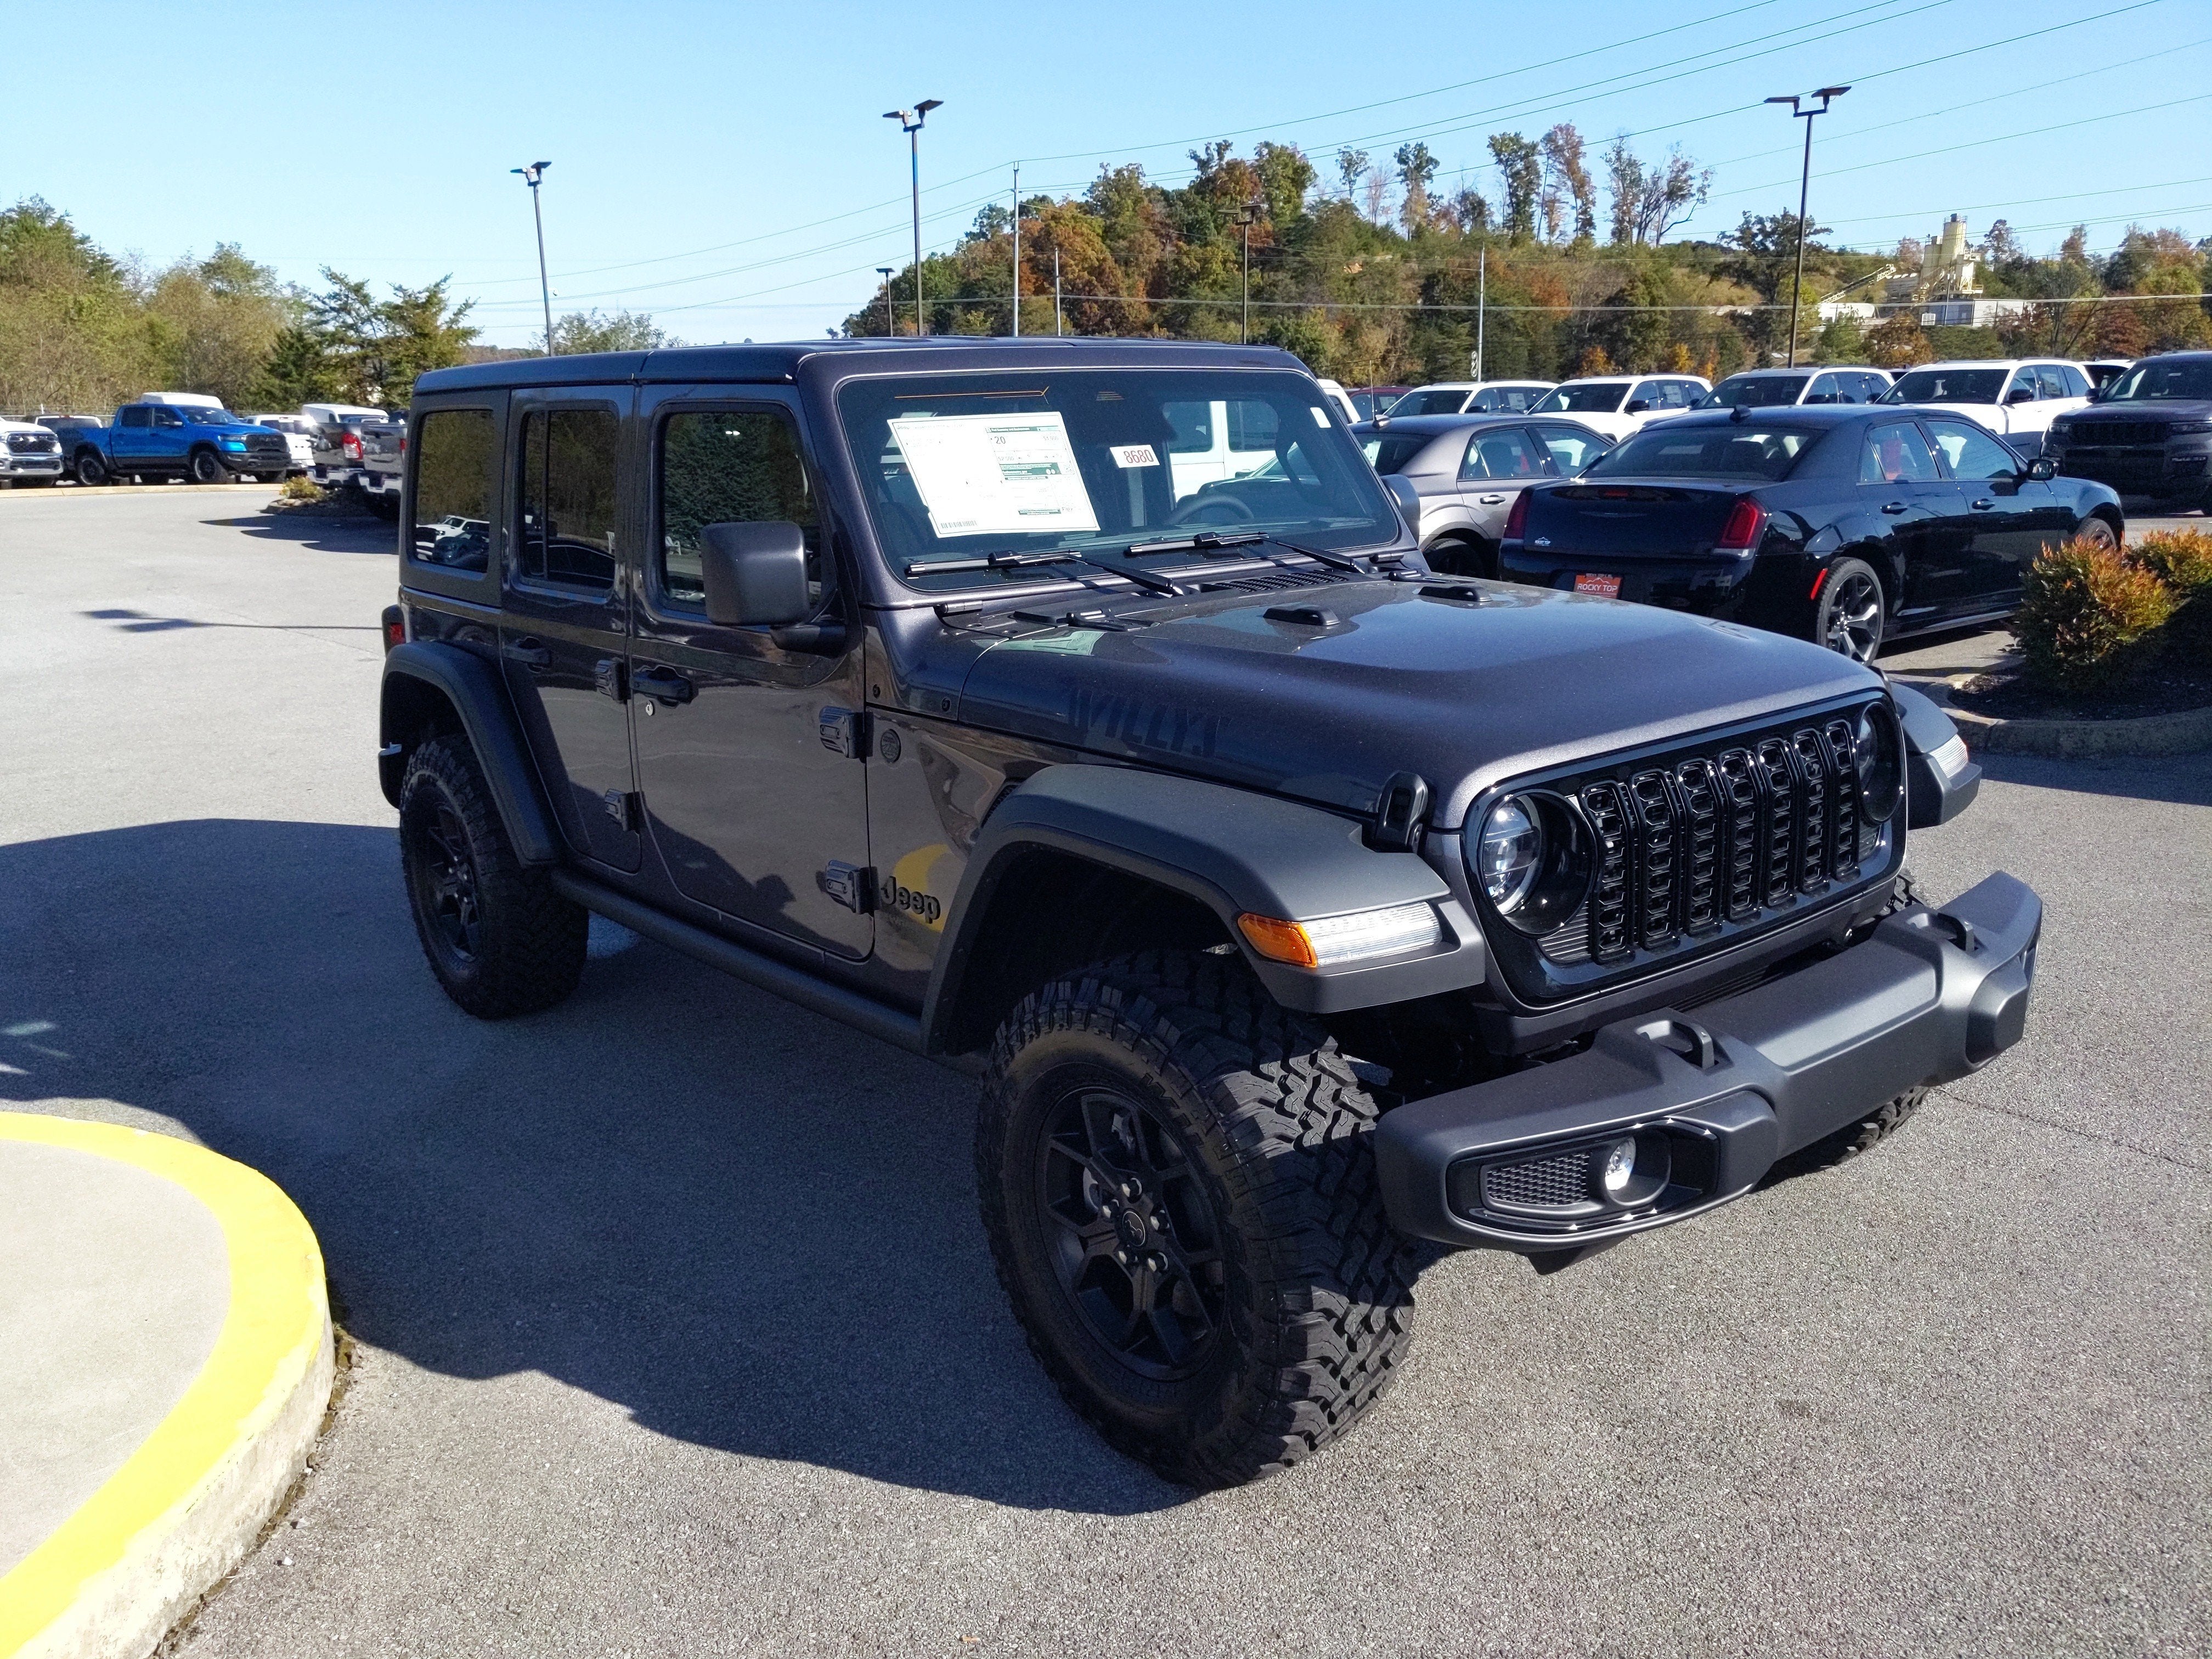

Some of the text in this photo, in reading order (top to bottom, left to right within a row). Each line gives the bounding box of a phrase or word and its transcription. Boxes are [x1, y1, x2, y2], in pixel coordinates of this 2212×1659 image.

[994, 436, 1006, 444] 20
[1123, 449, 1154, 464] 8680
[1577, 583, 1601, 591] ROCKY
[881, 875, 941, 924] Jeep
